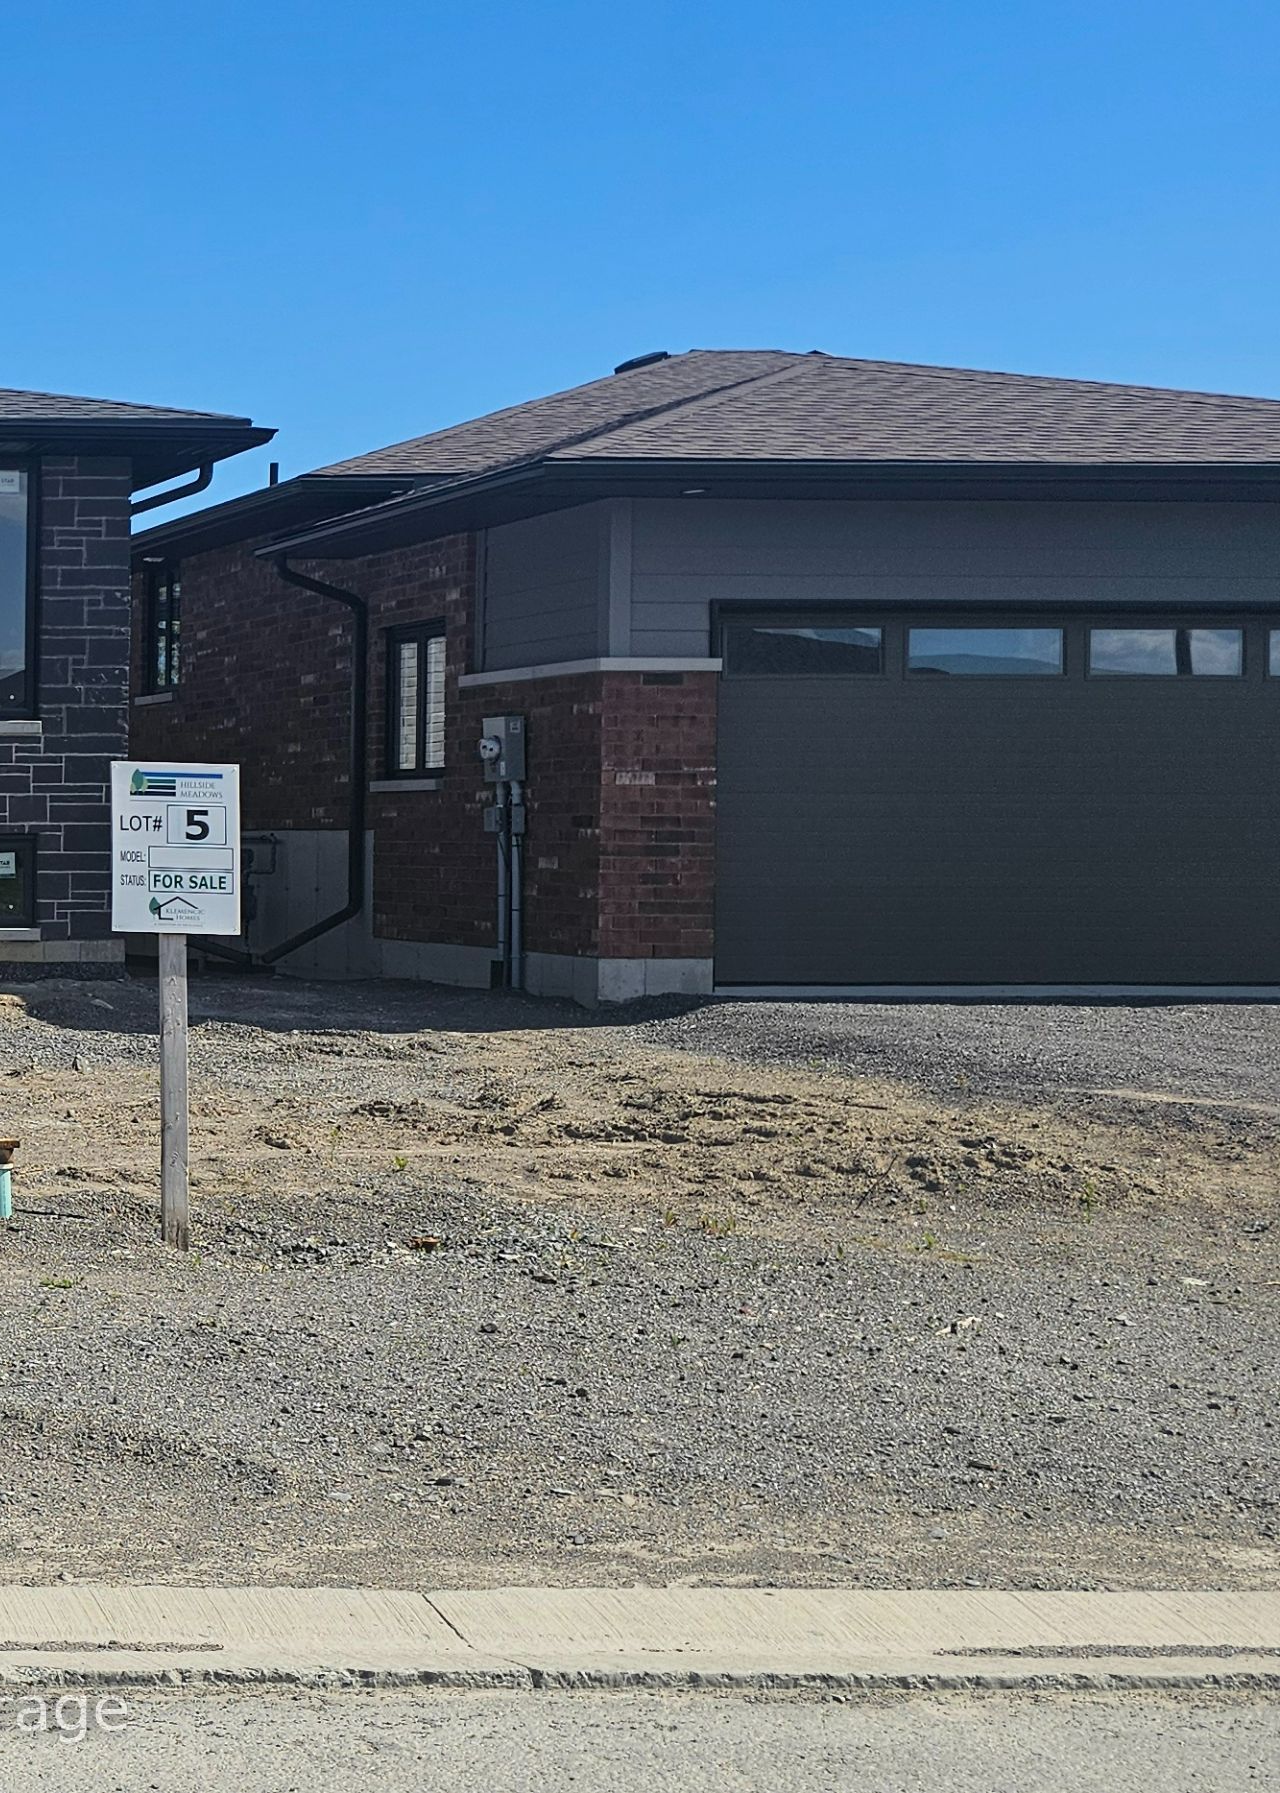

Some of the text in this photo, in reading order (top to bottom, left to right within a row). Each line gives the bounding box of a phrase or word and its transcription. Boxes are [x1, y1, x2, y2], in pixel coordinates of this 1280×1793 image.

[180, 781, 216, 790] HILLSIDE
[180, 790, 223, 799] MEADOWS
[120, 809, 210, 841] LOT# 5
[120, 850, 147, 863] MODEL:
[120, 873, 227, 890] STATUS: FOR SALE
